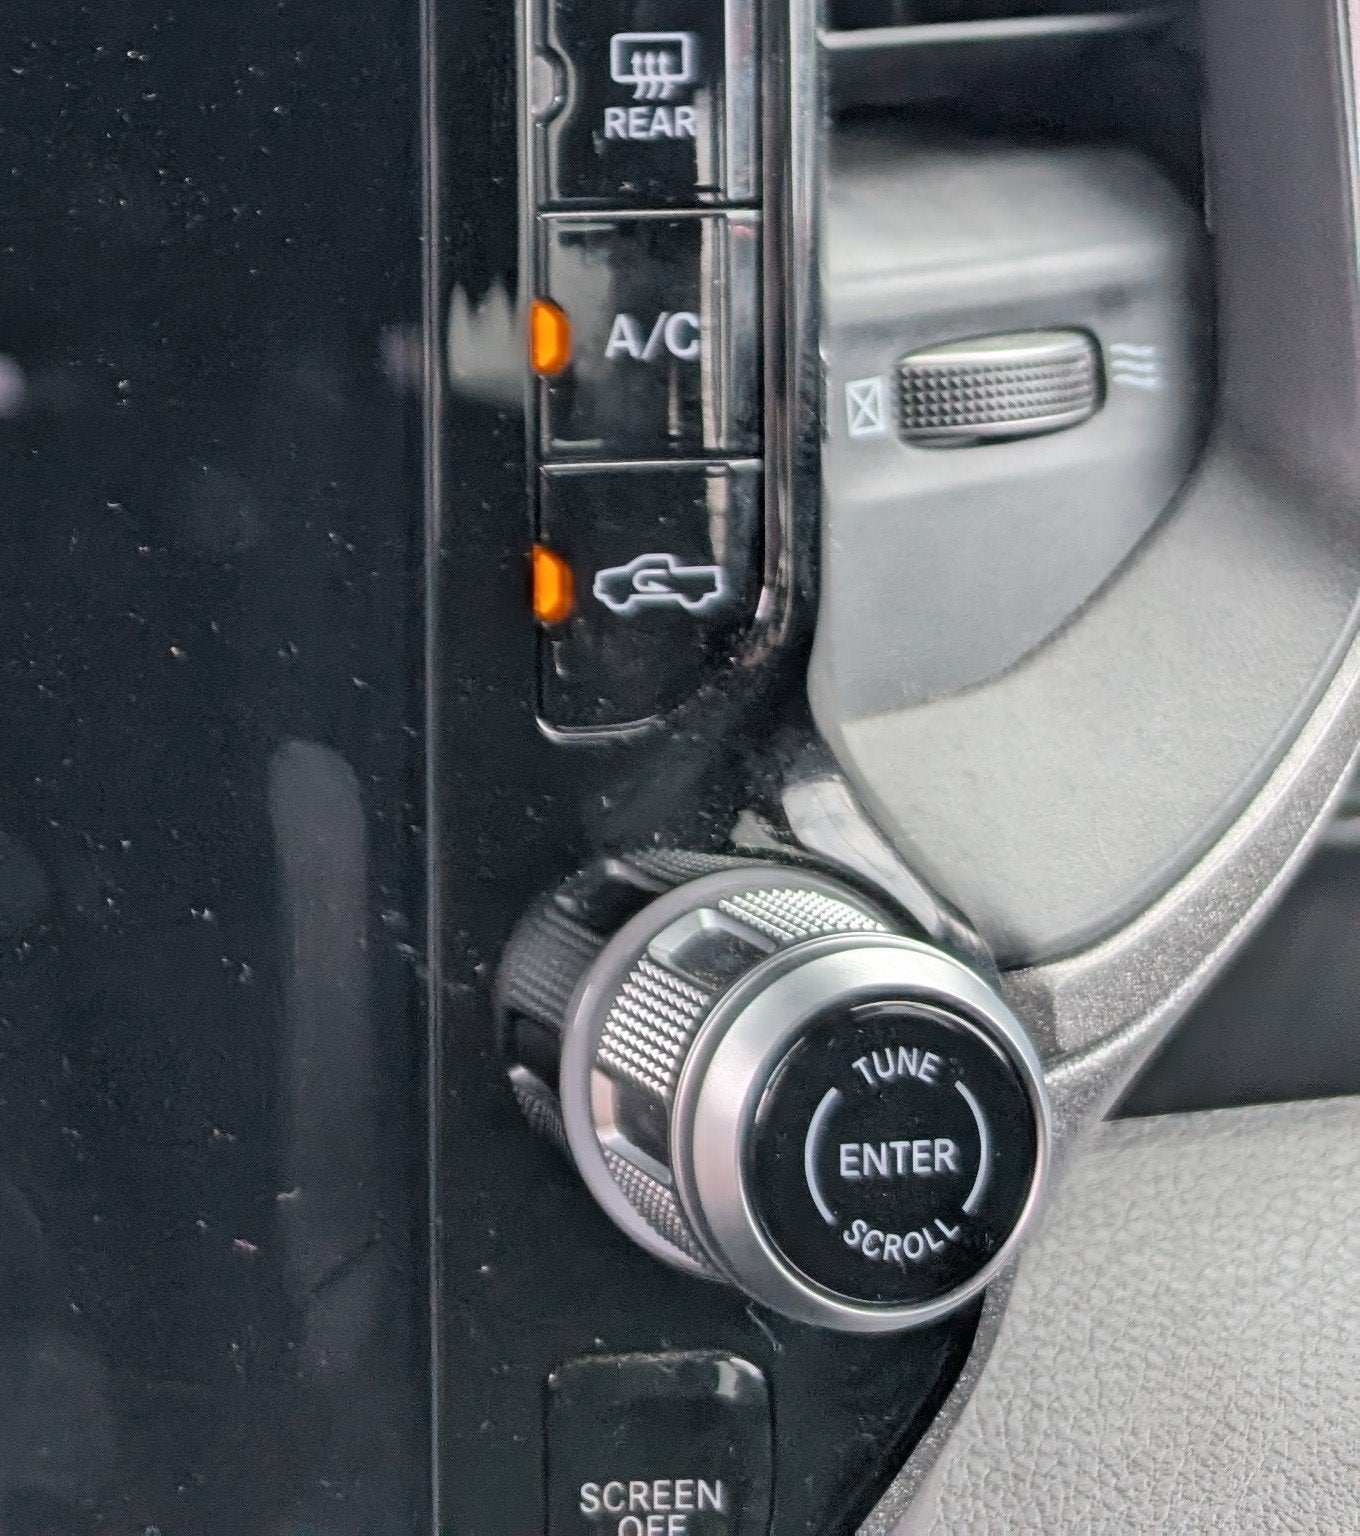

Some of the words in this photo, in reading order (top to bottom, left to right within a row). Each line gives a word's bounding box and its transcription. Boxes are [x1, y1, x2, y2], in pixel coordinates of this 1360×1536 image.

[604, 107, 696, 139] REAR
[605, 312, 703, 360] A/C
[852, 1046, 940, 1084] TUNE
[839, 1138, 958, 1178] ENTER
[843, 1218, 959, 1263] SCROLL
[580, 1479, 723, 1514] SCREEN
